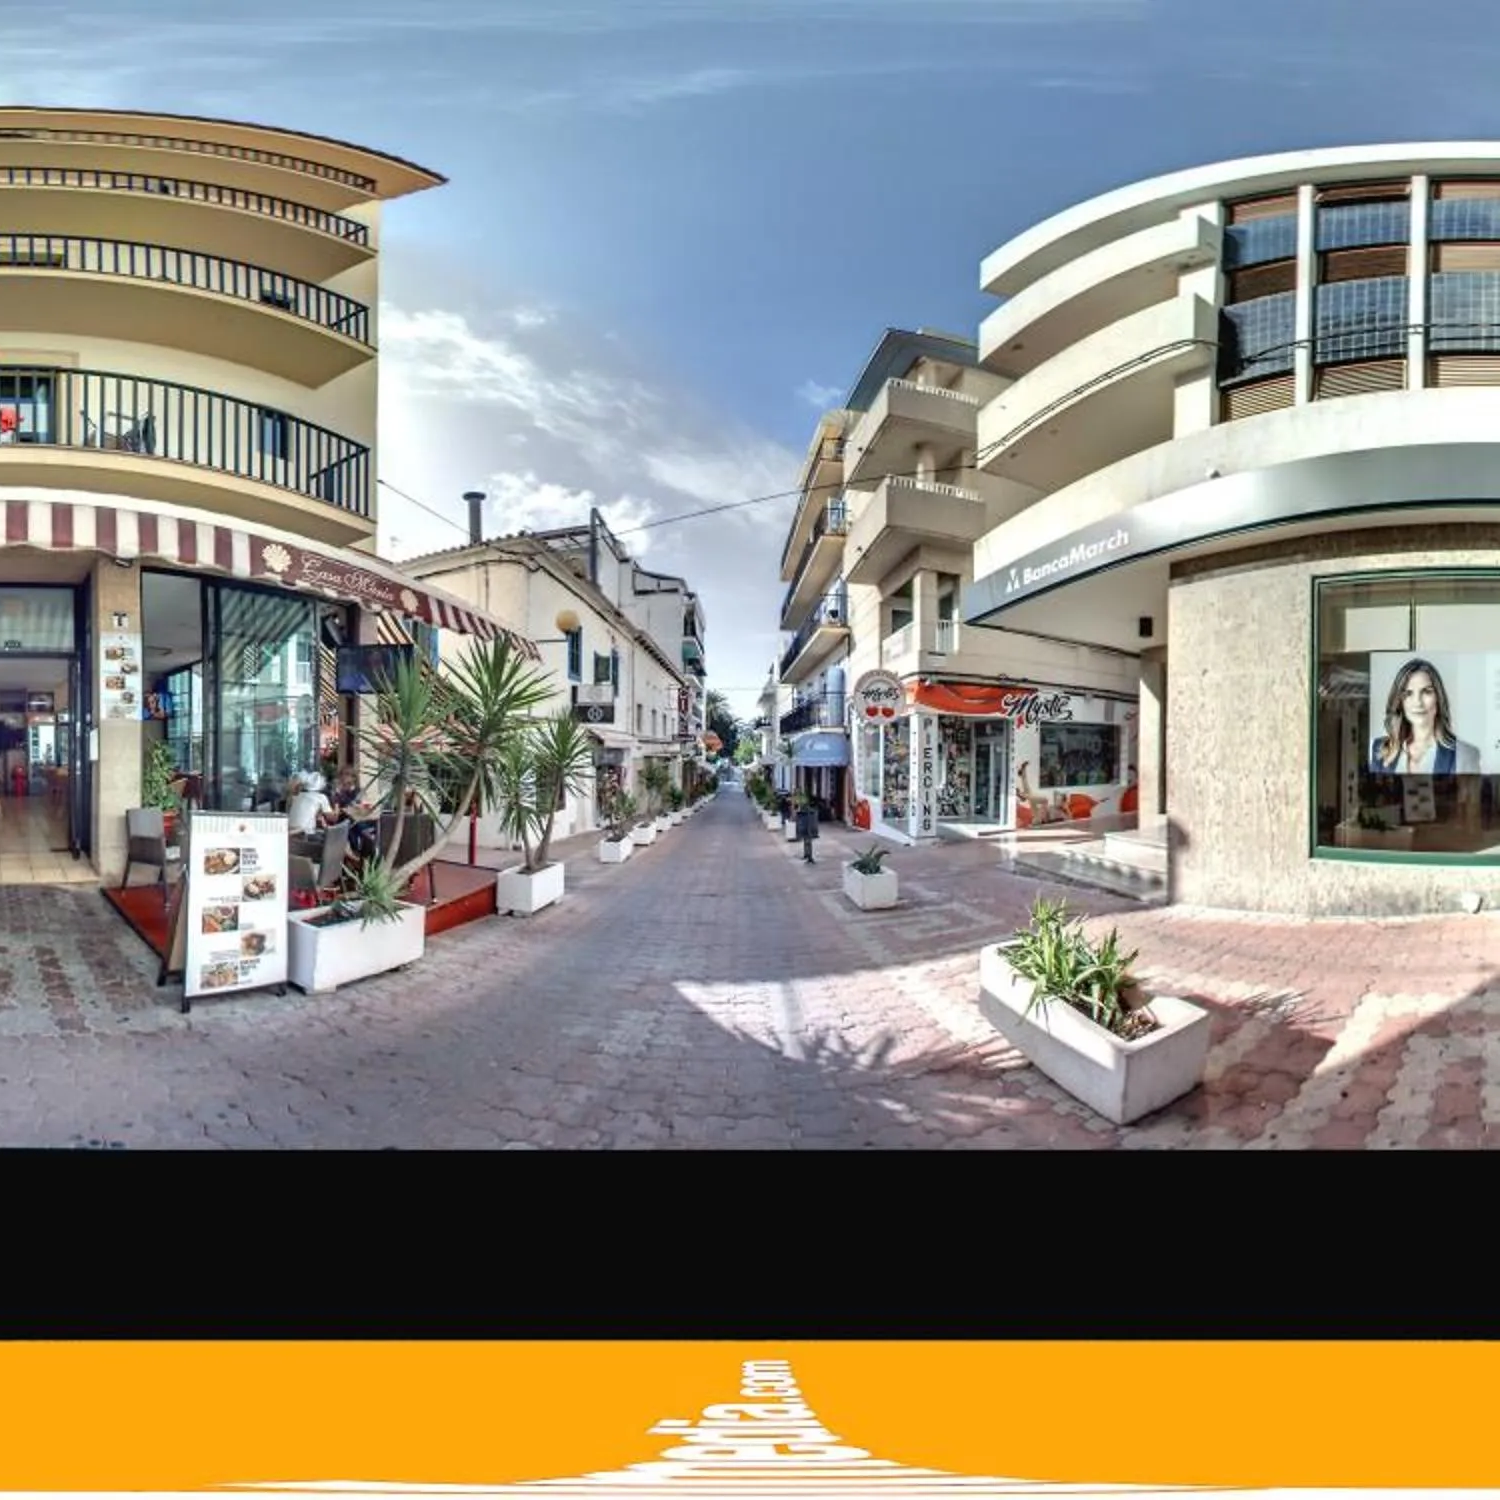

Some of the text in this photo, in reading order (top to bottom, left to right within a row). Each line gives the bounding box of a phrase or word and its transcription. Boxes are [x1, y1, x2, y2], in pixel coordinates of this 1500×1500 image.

[1022, 529, 1130, 586] BancaMarch
[1002, 693, 1073, 726] Mystic
[923, 718, 933, 831] PIERCING
